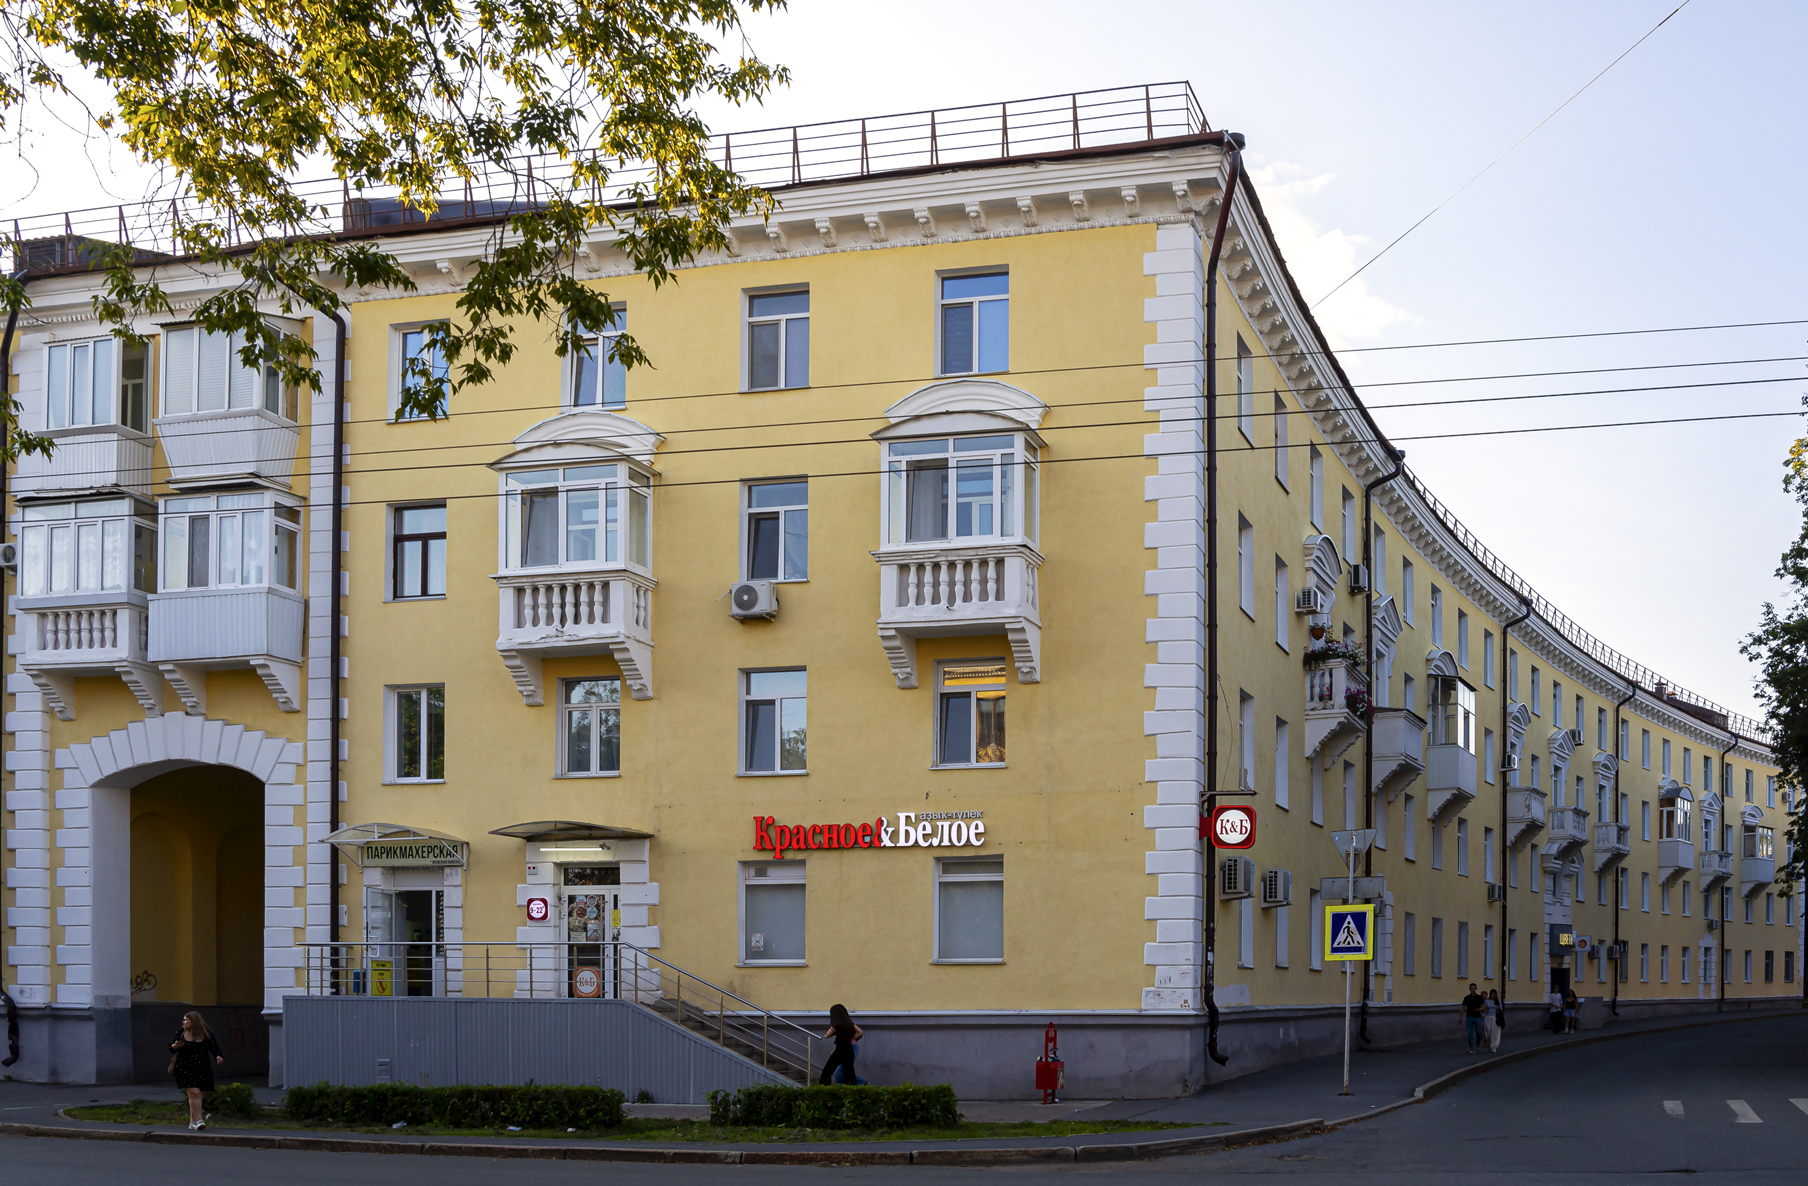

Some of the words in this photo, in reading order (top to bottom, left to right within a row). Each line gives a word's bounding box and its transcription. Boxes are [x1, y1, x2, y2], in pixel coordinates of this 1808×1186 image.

[1219, 819, 1248, 835] К&Б
[753, 812, 984, 859] Красное&Белое
[366, 844, 458, 860] ПАРИКМАХЕРСКАЯ
